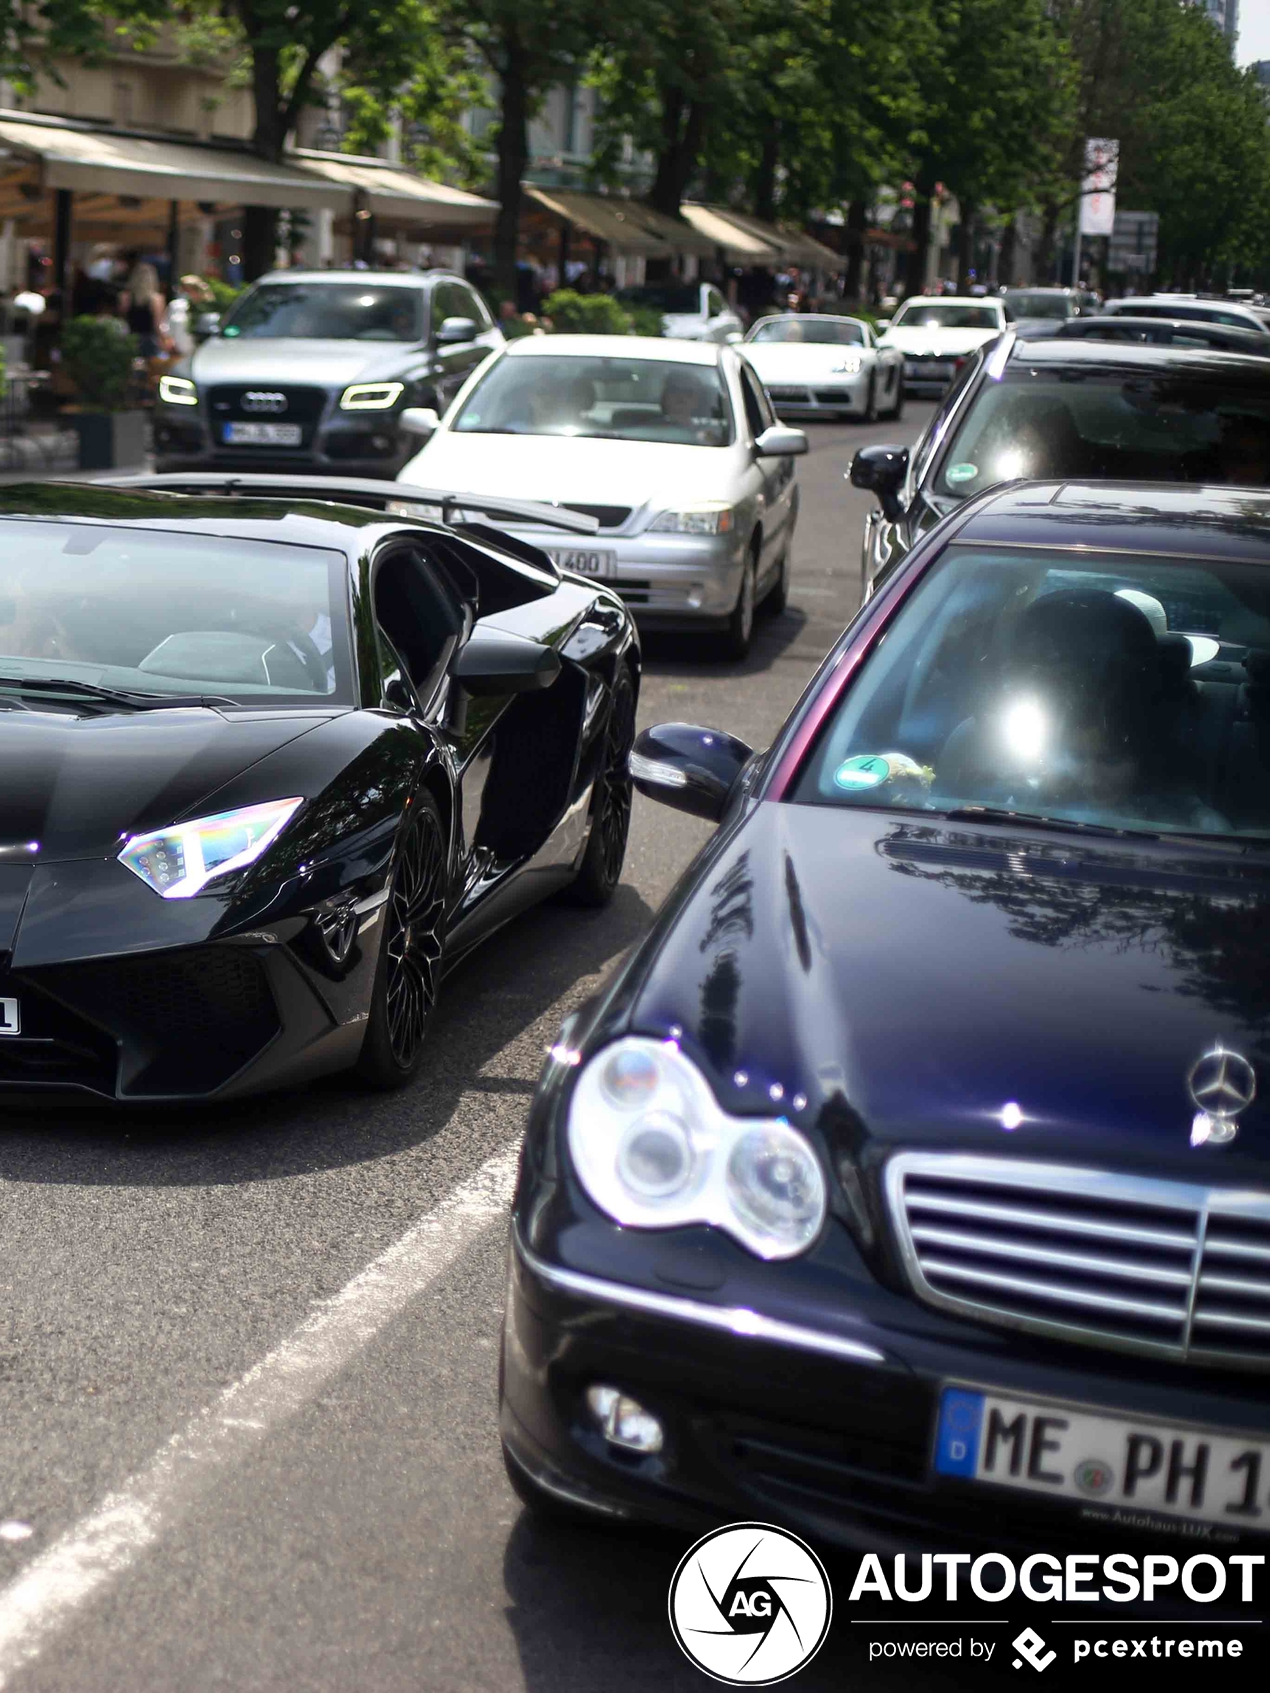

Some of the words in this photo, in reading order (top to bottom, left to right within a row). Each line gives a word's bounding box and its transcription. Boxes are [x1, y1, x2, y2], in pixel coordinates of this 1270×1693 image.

[565, 551, 599, 572] 400
[859, 758, 877, 772] 4
[949, 1441, 966, 1460] D
[984, 1407, 1070, 1484] ME
[1122, 1433, 1210, 1509] PH
[1224, 1450, 1270, 1517] 1
